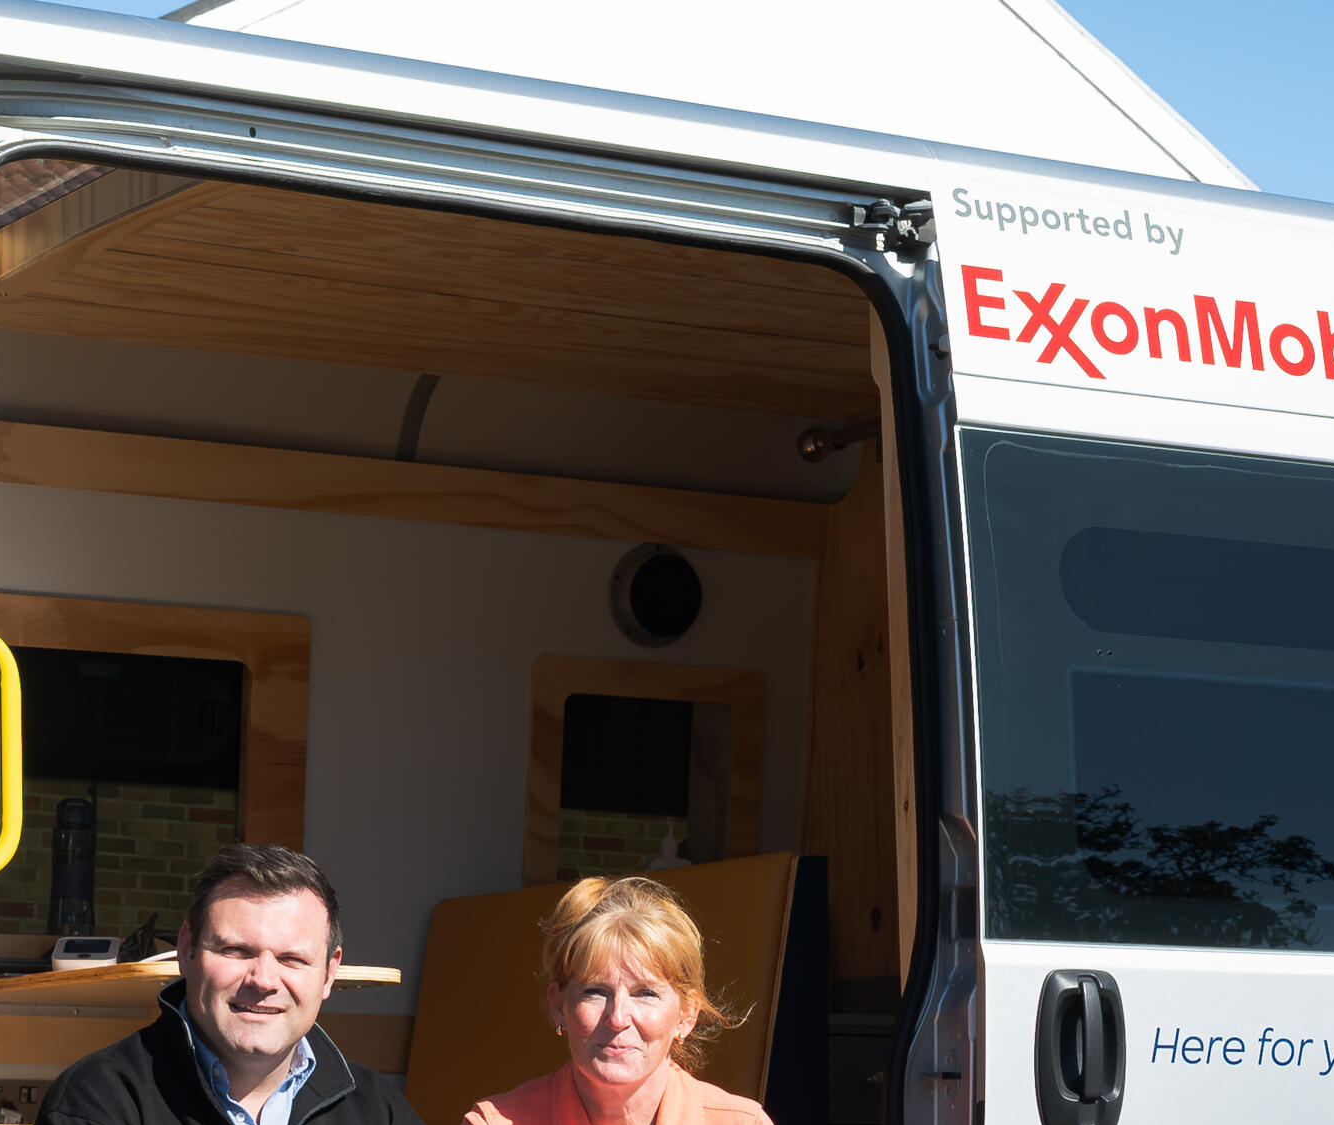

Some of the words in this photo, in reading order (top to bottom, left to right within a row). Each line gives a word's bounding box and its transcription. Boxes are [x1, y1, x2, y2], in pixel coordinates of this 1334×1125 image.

[953, 188, 1132, 240] Supported
[1144, 213, 1183, 255] by
[1152, 1028, 1245, 1065] Here
[1259, 1028, 1313, 1066] for
